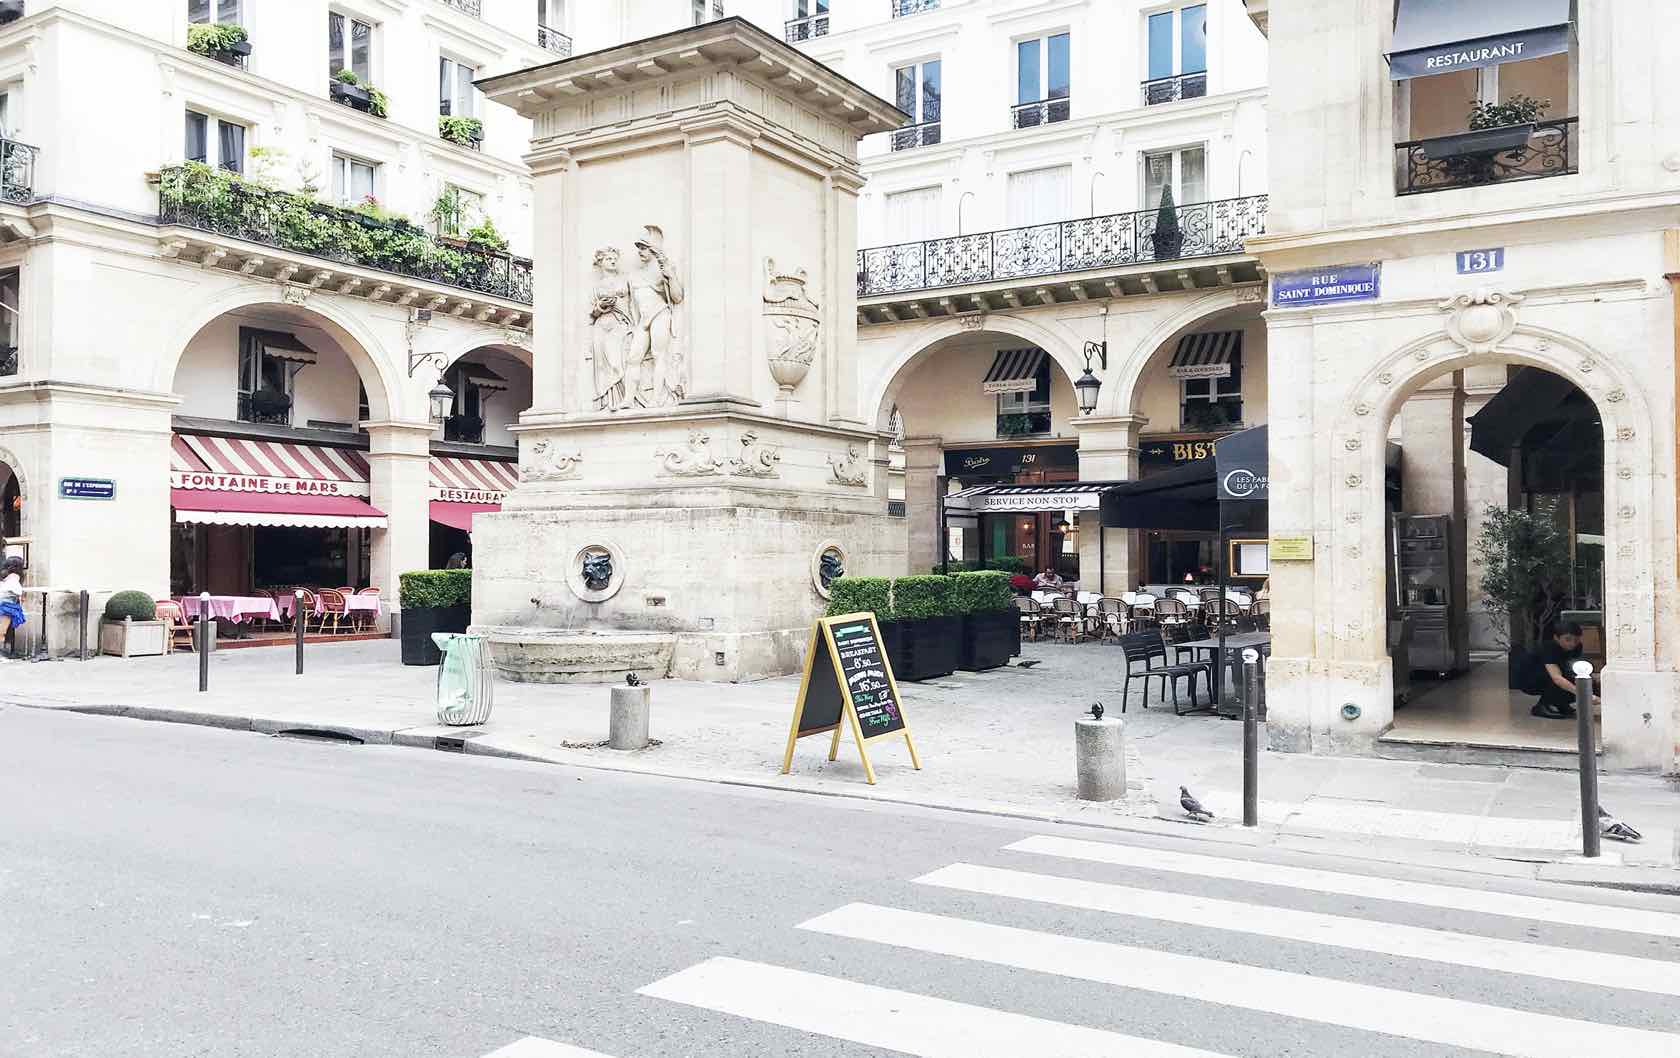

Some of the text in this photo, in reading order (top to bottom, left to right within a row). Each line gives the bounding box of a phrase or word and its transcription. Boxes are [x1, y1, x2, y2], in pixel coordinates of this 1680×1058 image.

[1427, 42, 1524, 68] RESTAURANT
[1463, 250, 1497, 272] 131
[1312, 275, 1338, 286] RUE
[1279, 283, 1374, 300] SAINT DOMINIQUE
[181, 474, 269, 489] FONTAINE
[275, 482, 291, 490] DE
[296, 481, 338, 493] MARS
[984, 498, 1025, 506] SERVICE
